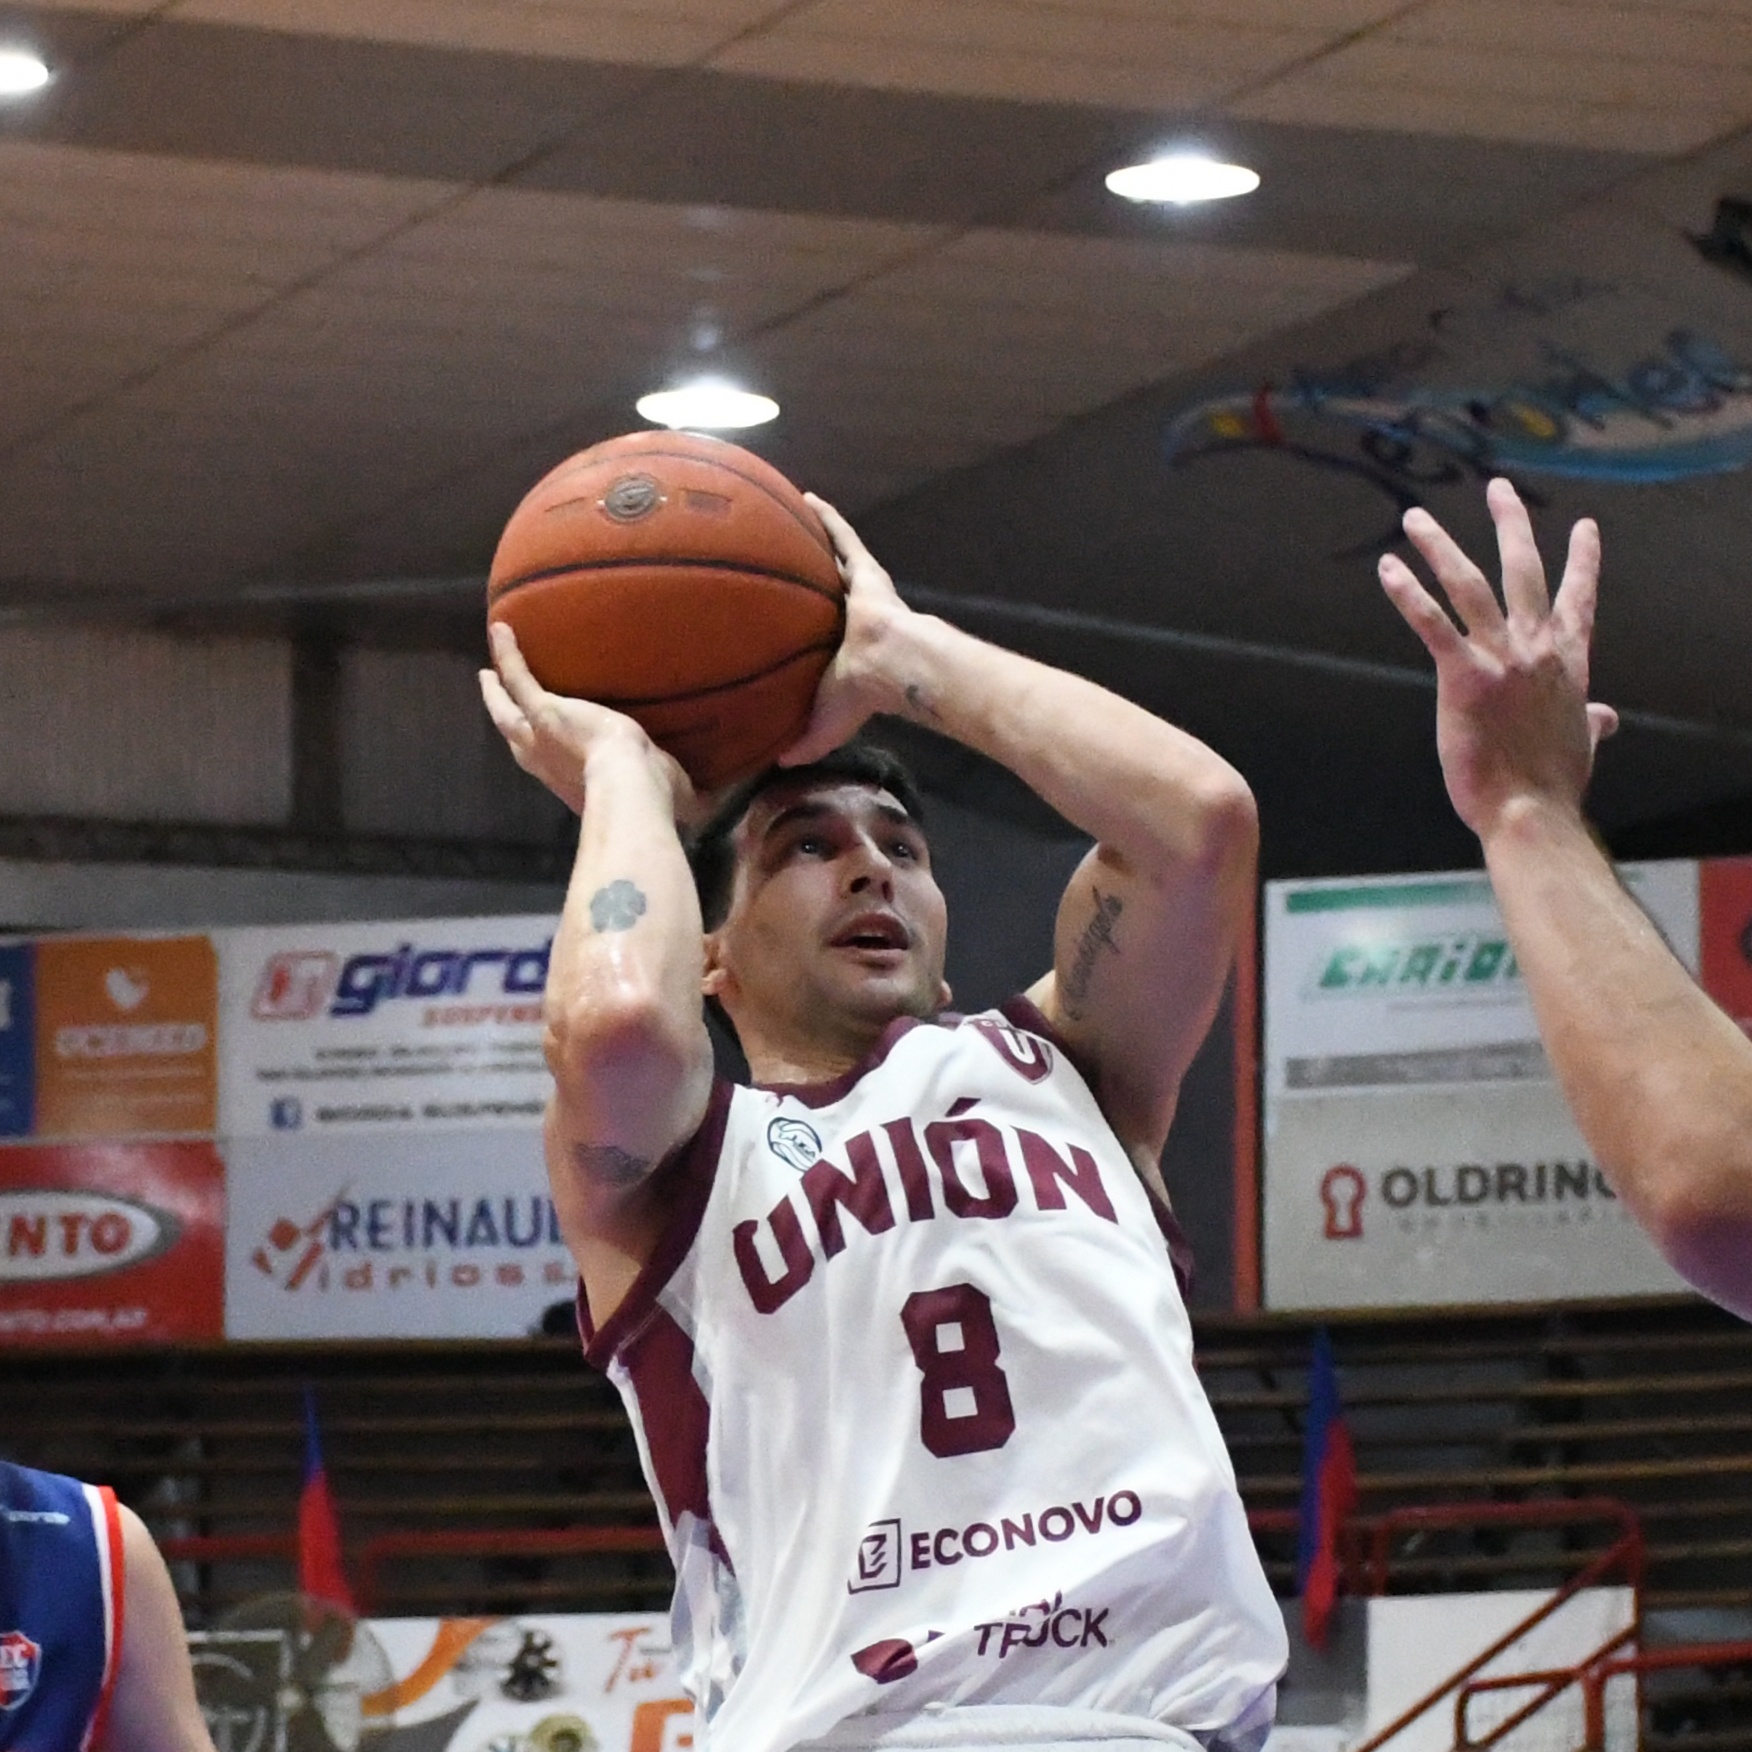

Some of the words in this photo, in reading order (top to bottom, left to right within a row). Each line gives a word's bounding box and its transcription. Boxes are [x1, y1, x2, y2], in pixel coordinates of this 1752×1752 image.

[732, 1097, 1119, 1316] UNIÓN
[900, 1283, 1016, 1459] 8
[910, 1489, 1143, 1571] ECONOVO
